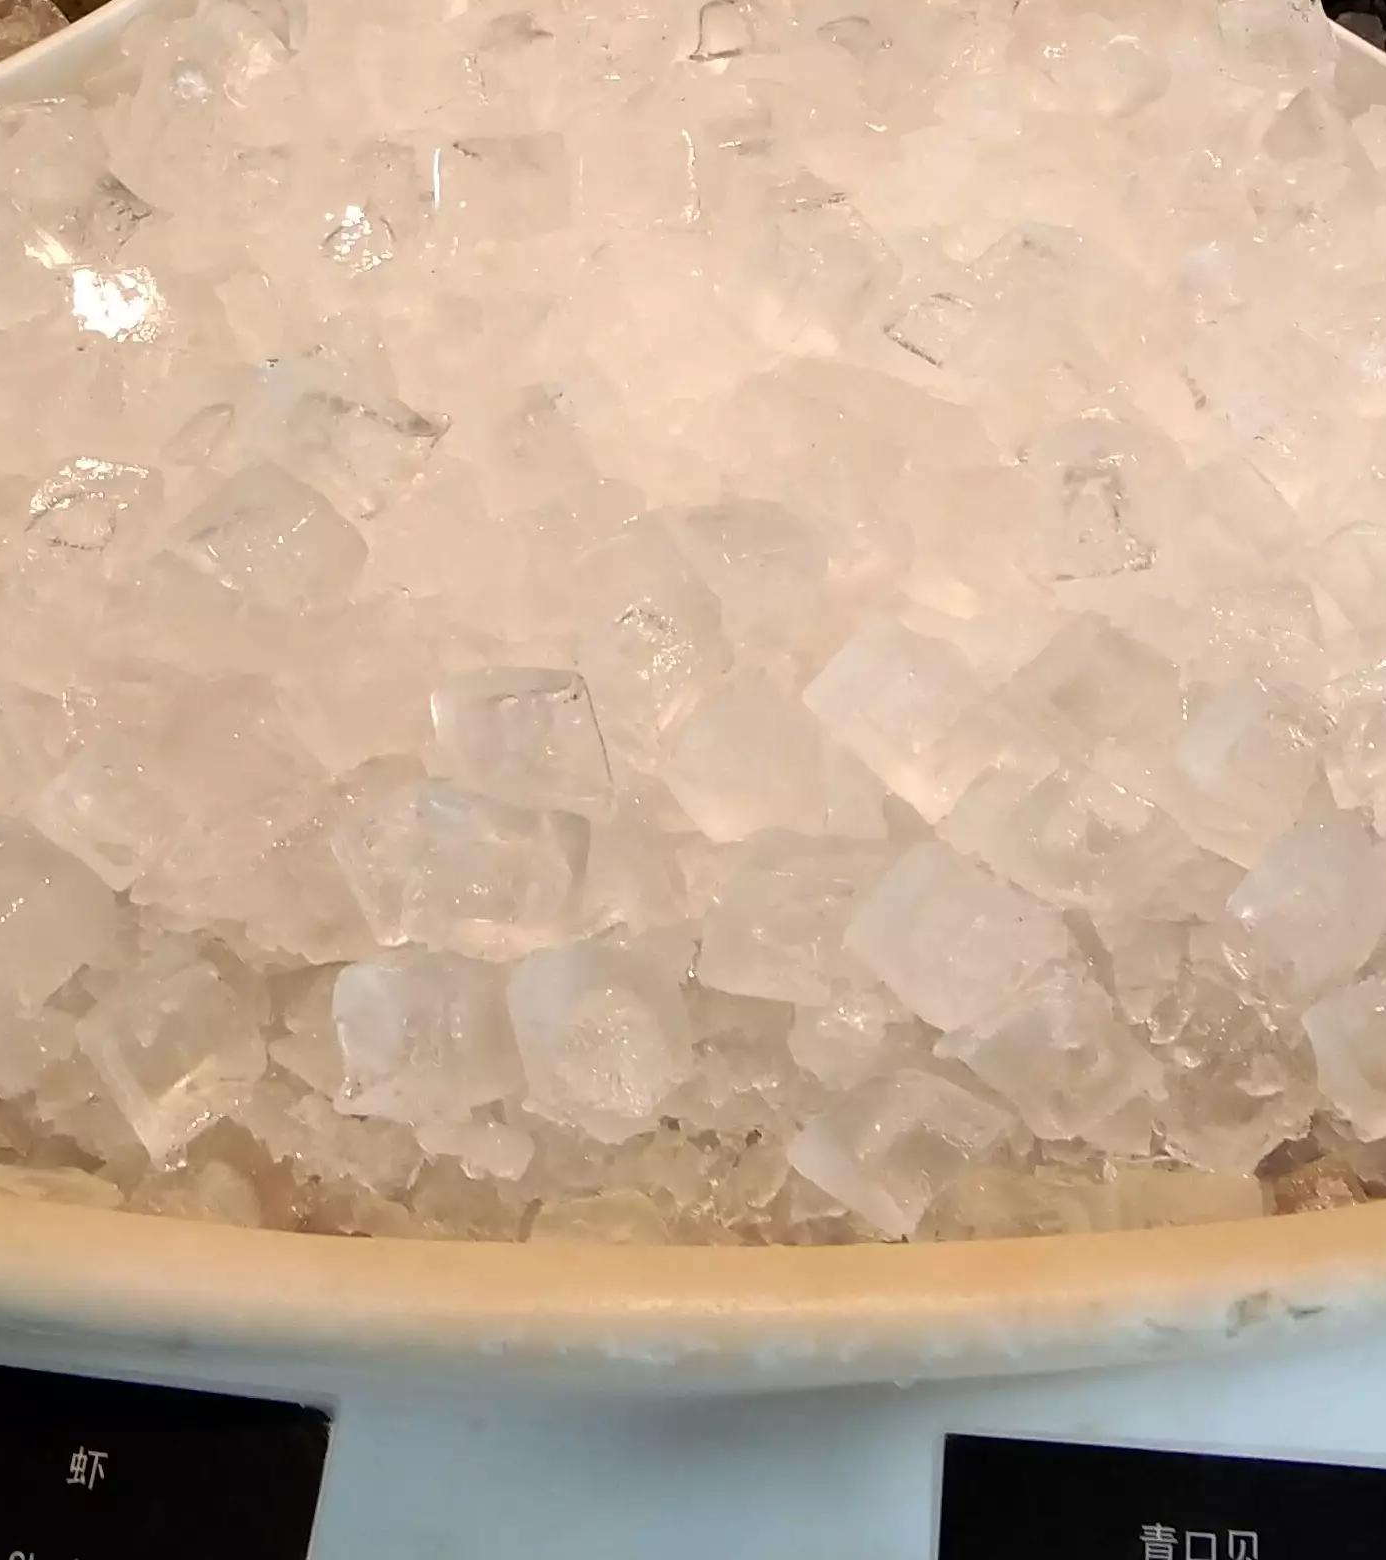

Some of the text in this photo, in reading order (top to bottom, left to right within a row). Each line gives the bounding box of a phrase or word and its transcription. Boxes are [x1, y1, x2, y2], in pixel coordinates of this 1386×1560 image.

[66, 1445, 109, 1491] 虾
[1139, 1523, 1258, 1560] 青口贝
